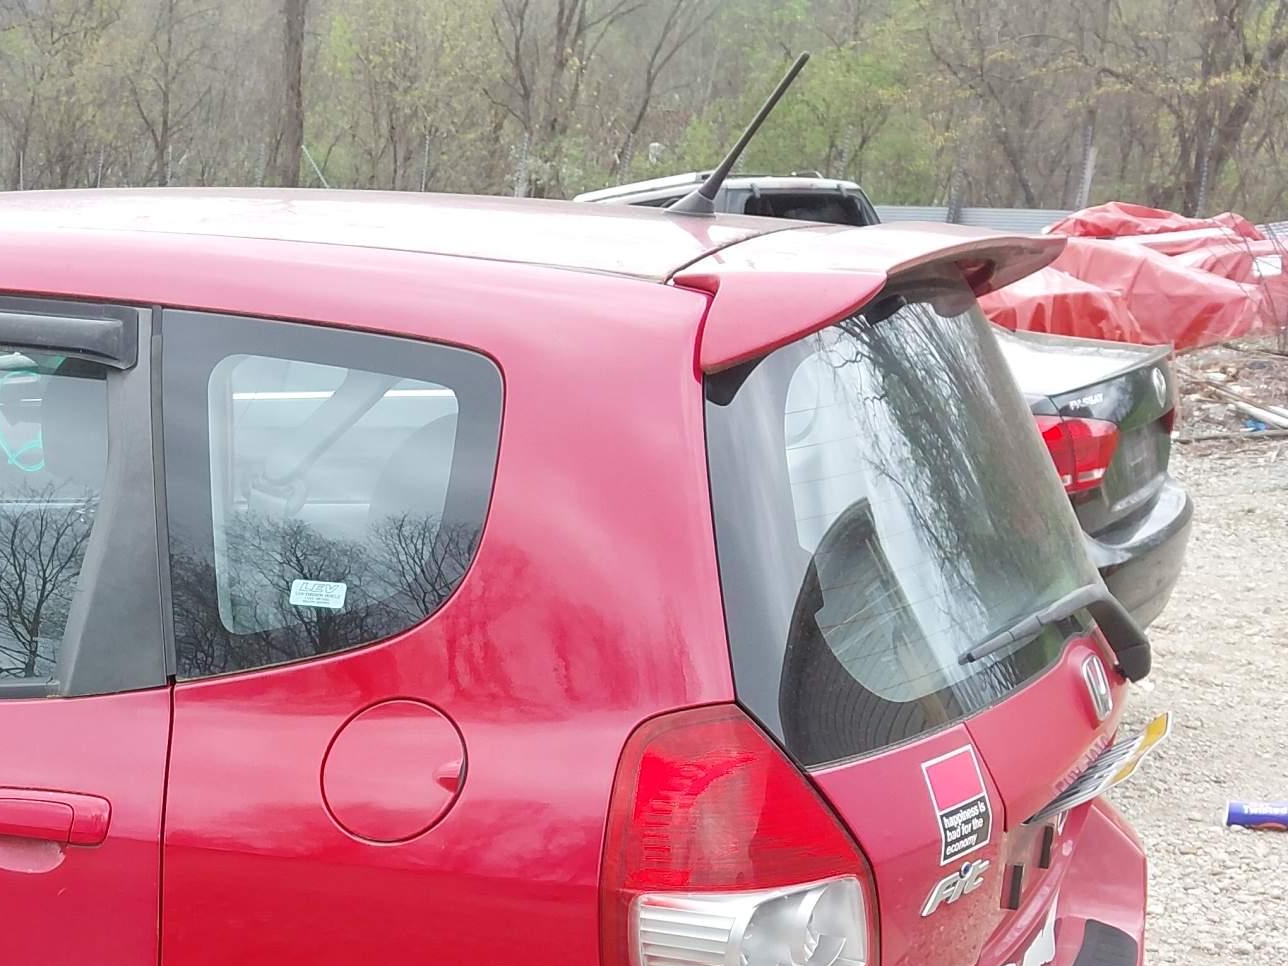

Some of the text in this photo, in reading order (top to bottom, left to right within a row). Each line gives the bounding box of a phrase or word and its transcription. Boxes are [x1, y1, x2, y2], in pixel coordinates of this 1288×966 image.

[300, 582, 340, 593] LEV
[942, 801, 987, 829] happiness is
[946, 816, 984, 842] bad for the
[945, 833, 977, 855] economy
